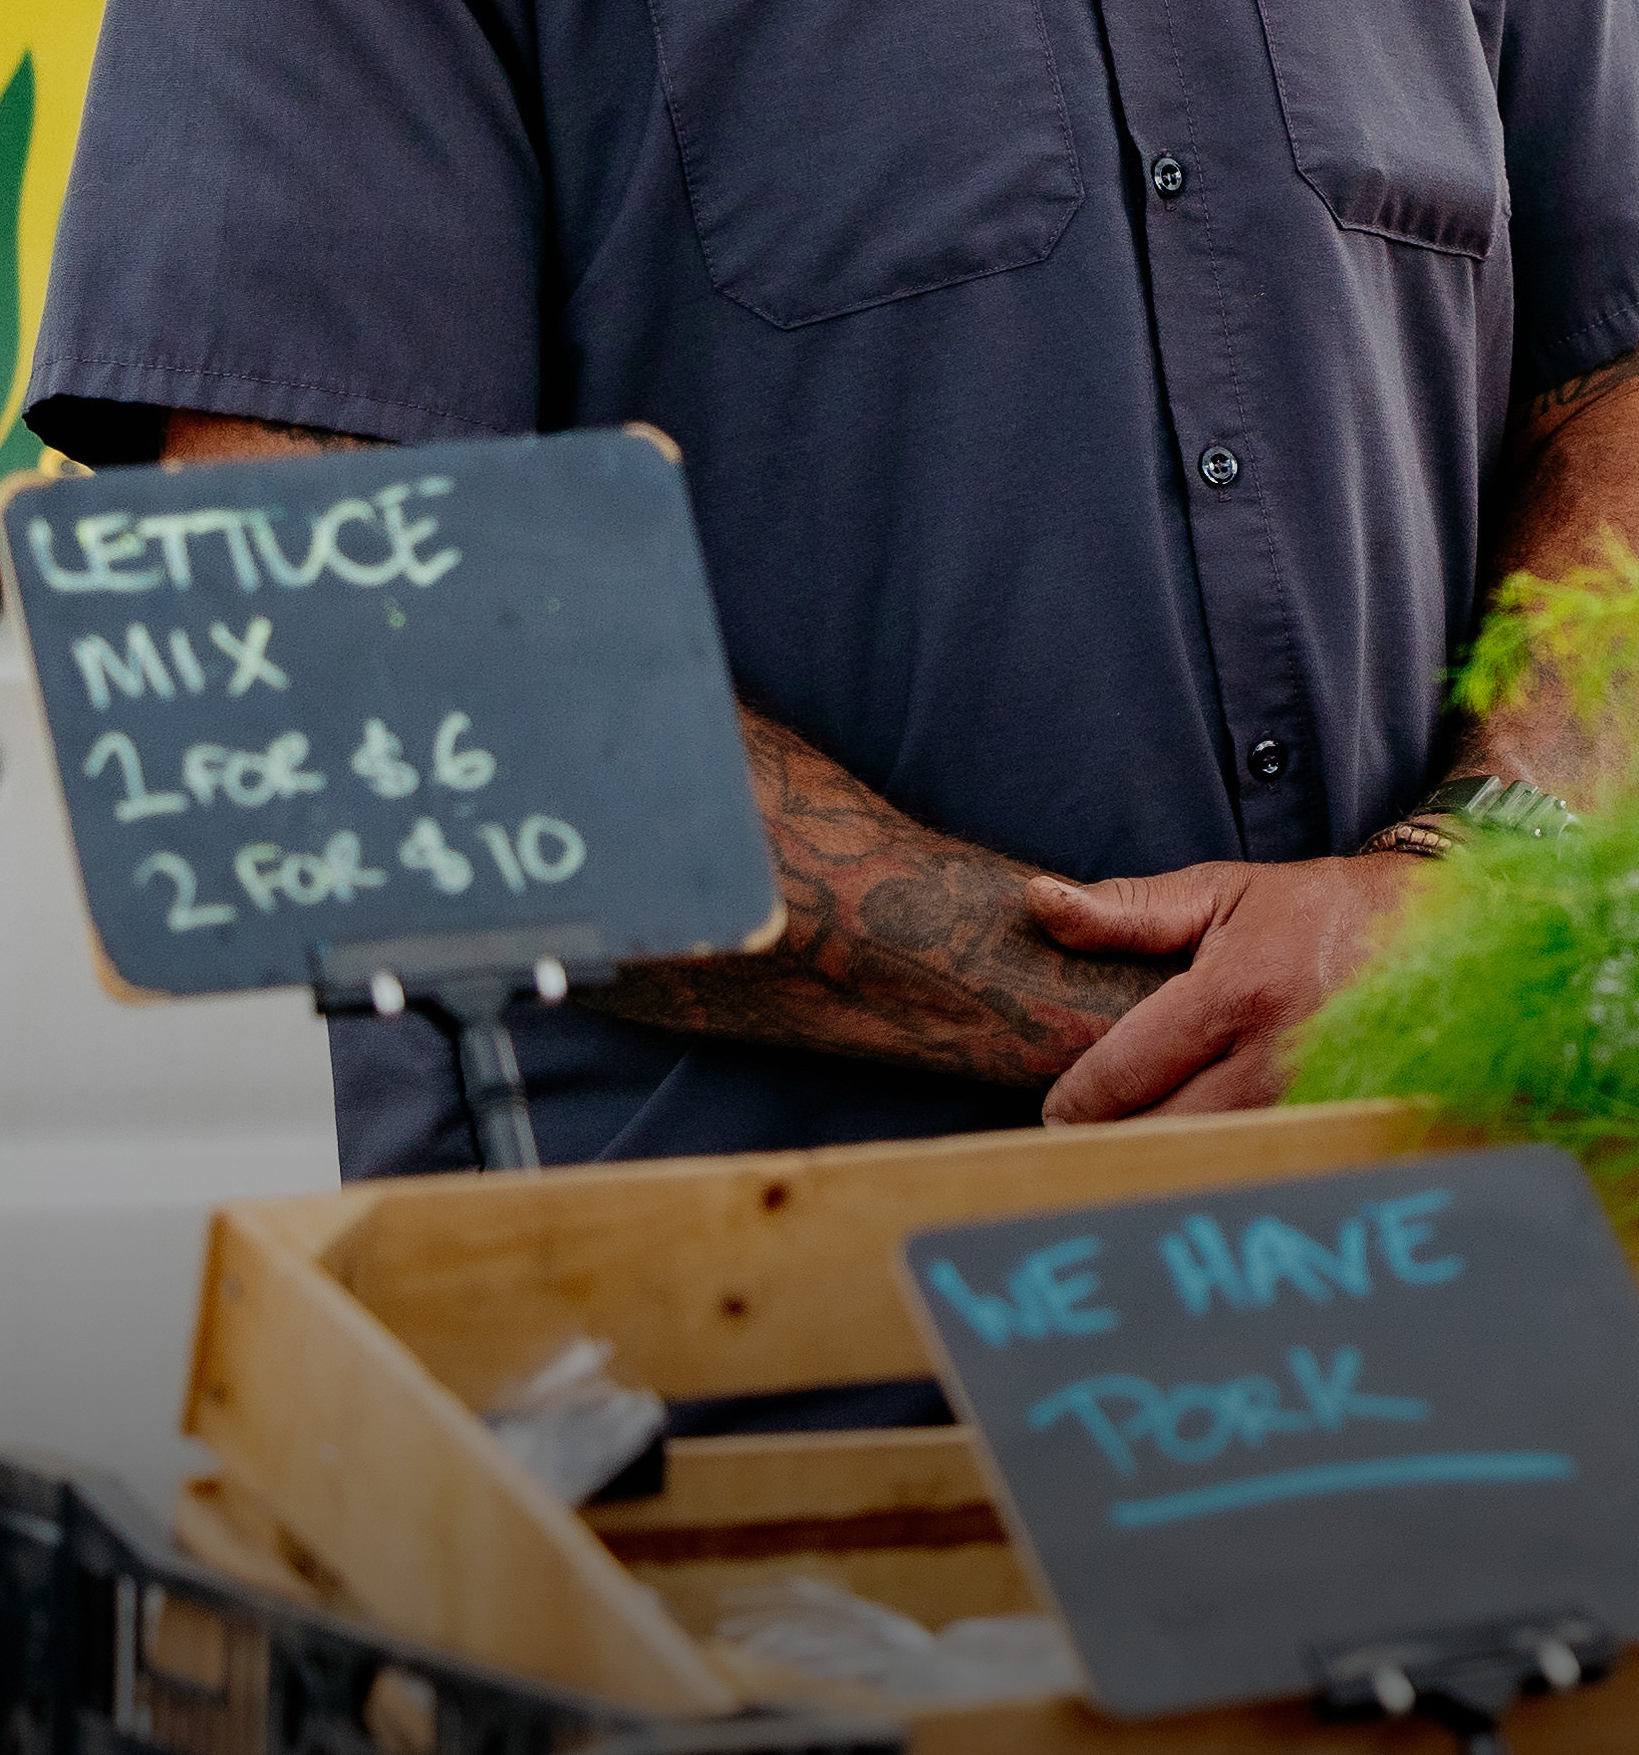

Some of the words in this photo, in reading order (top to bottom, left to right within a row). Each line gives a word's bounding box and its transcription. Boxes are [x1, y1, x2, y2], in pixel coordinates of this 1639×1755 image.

[27, 475, 462, 595] LETTUCE
[71, 617, 290, 711] MIX
[85, 733, 188, 823] 1
[184, 733, 328, 810] FOR
[351, 710, 496, 800] $6
[132, 853, 238, 933] 2
[232, 831, 388, 913] FOR
[398, 813, 590, 897] $10
[926, 1237, 1122, 1347] WE
[1164, 1188, 1466, 1317] HAVE
[1026, 1345, 1432, 1480] PORK
